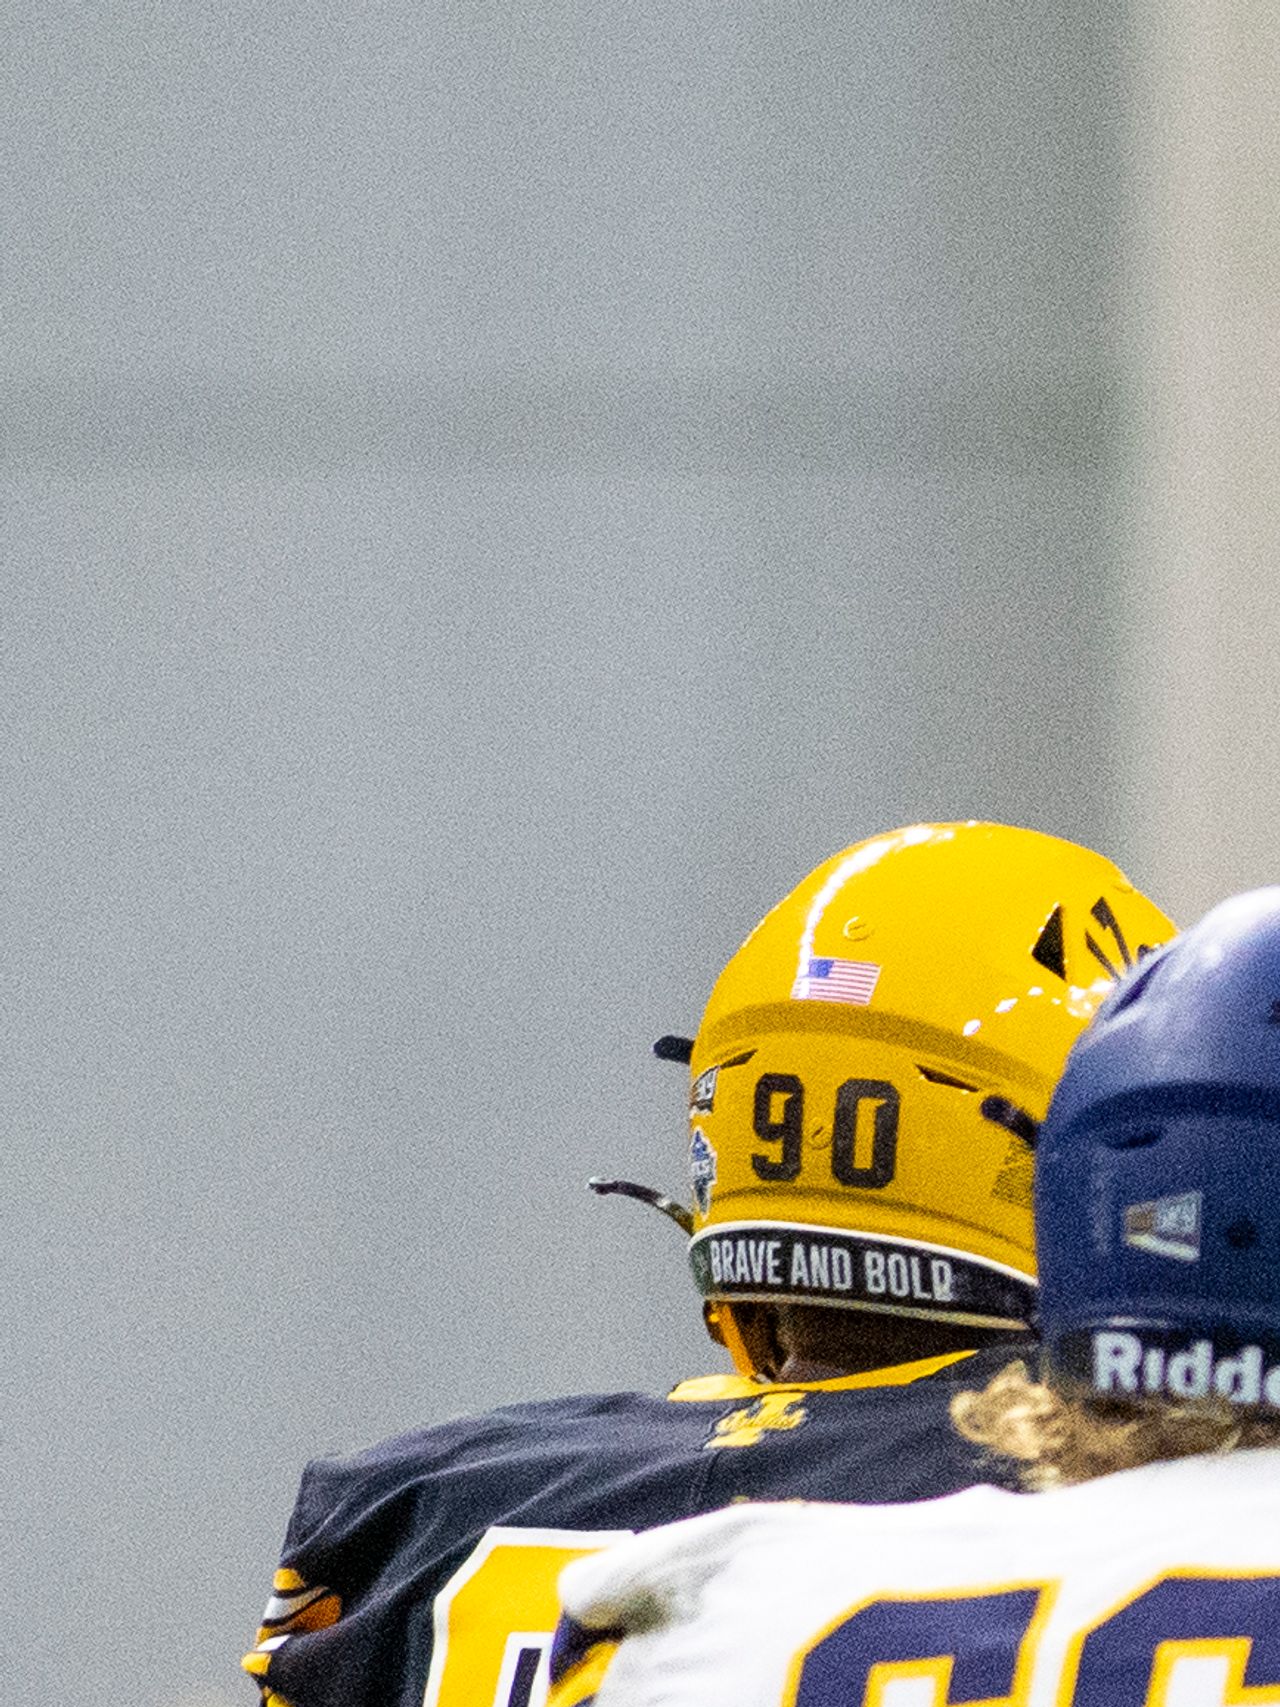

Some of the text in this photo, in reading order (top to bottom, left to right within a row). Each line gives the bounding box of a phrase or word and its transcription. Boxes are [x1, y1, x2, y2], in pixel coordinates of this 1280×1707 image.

[751, 1072, 900, 1189] 90
[709, 1239, 951, 1301] BRAVE AND BOLD
